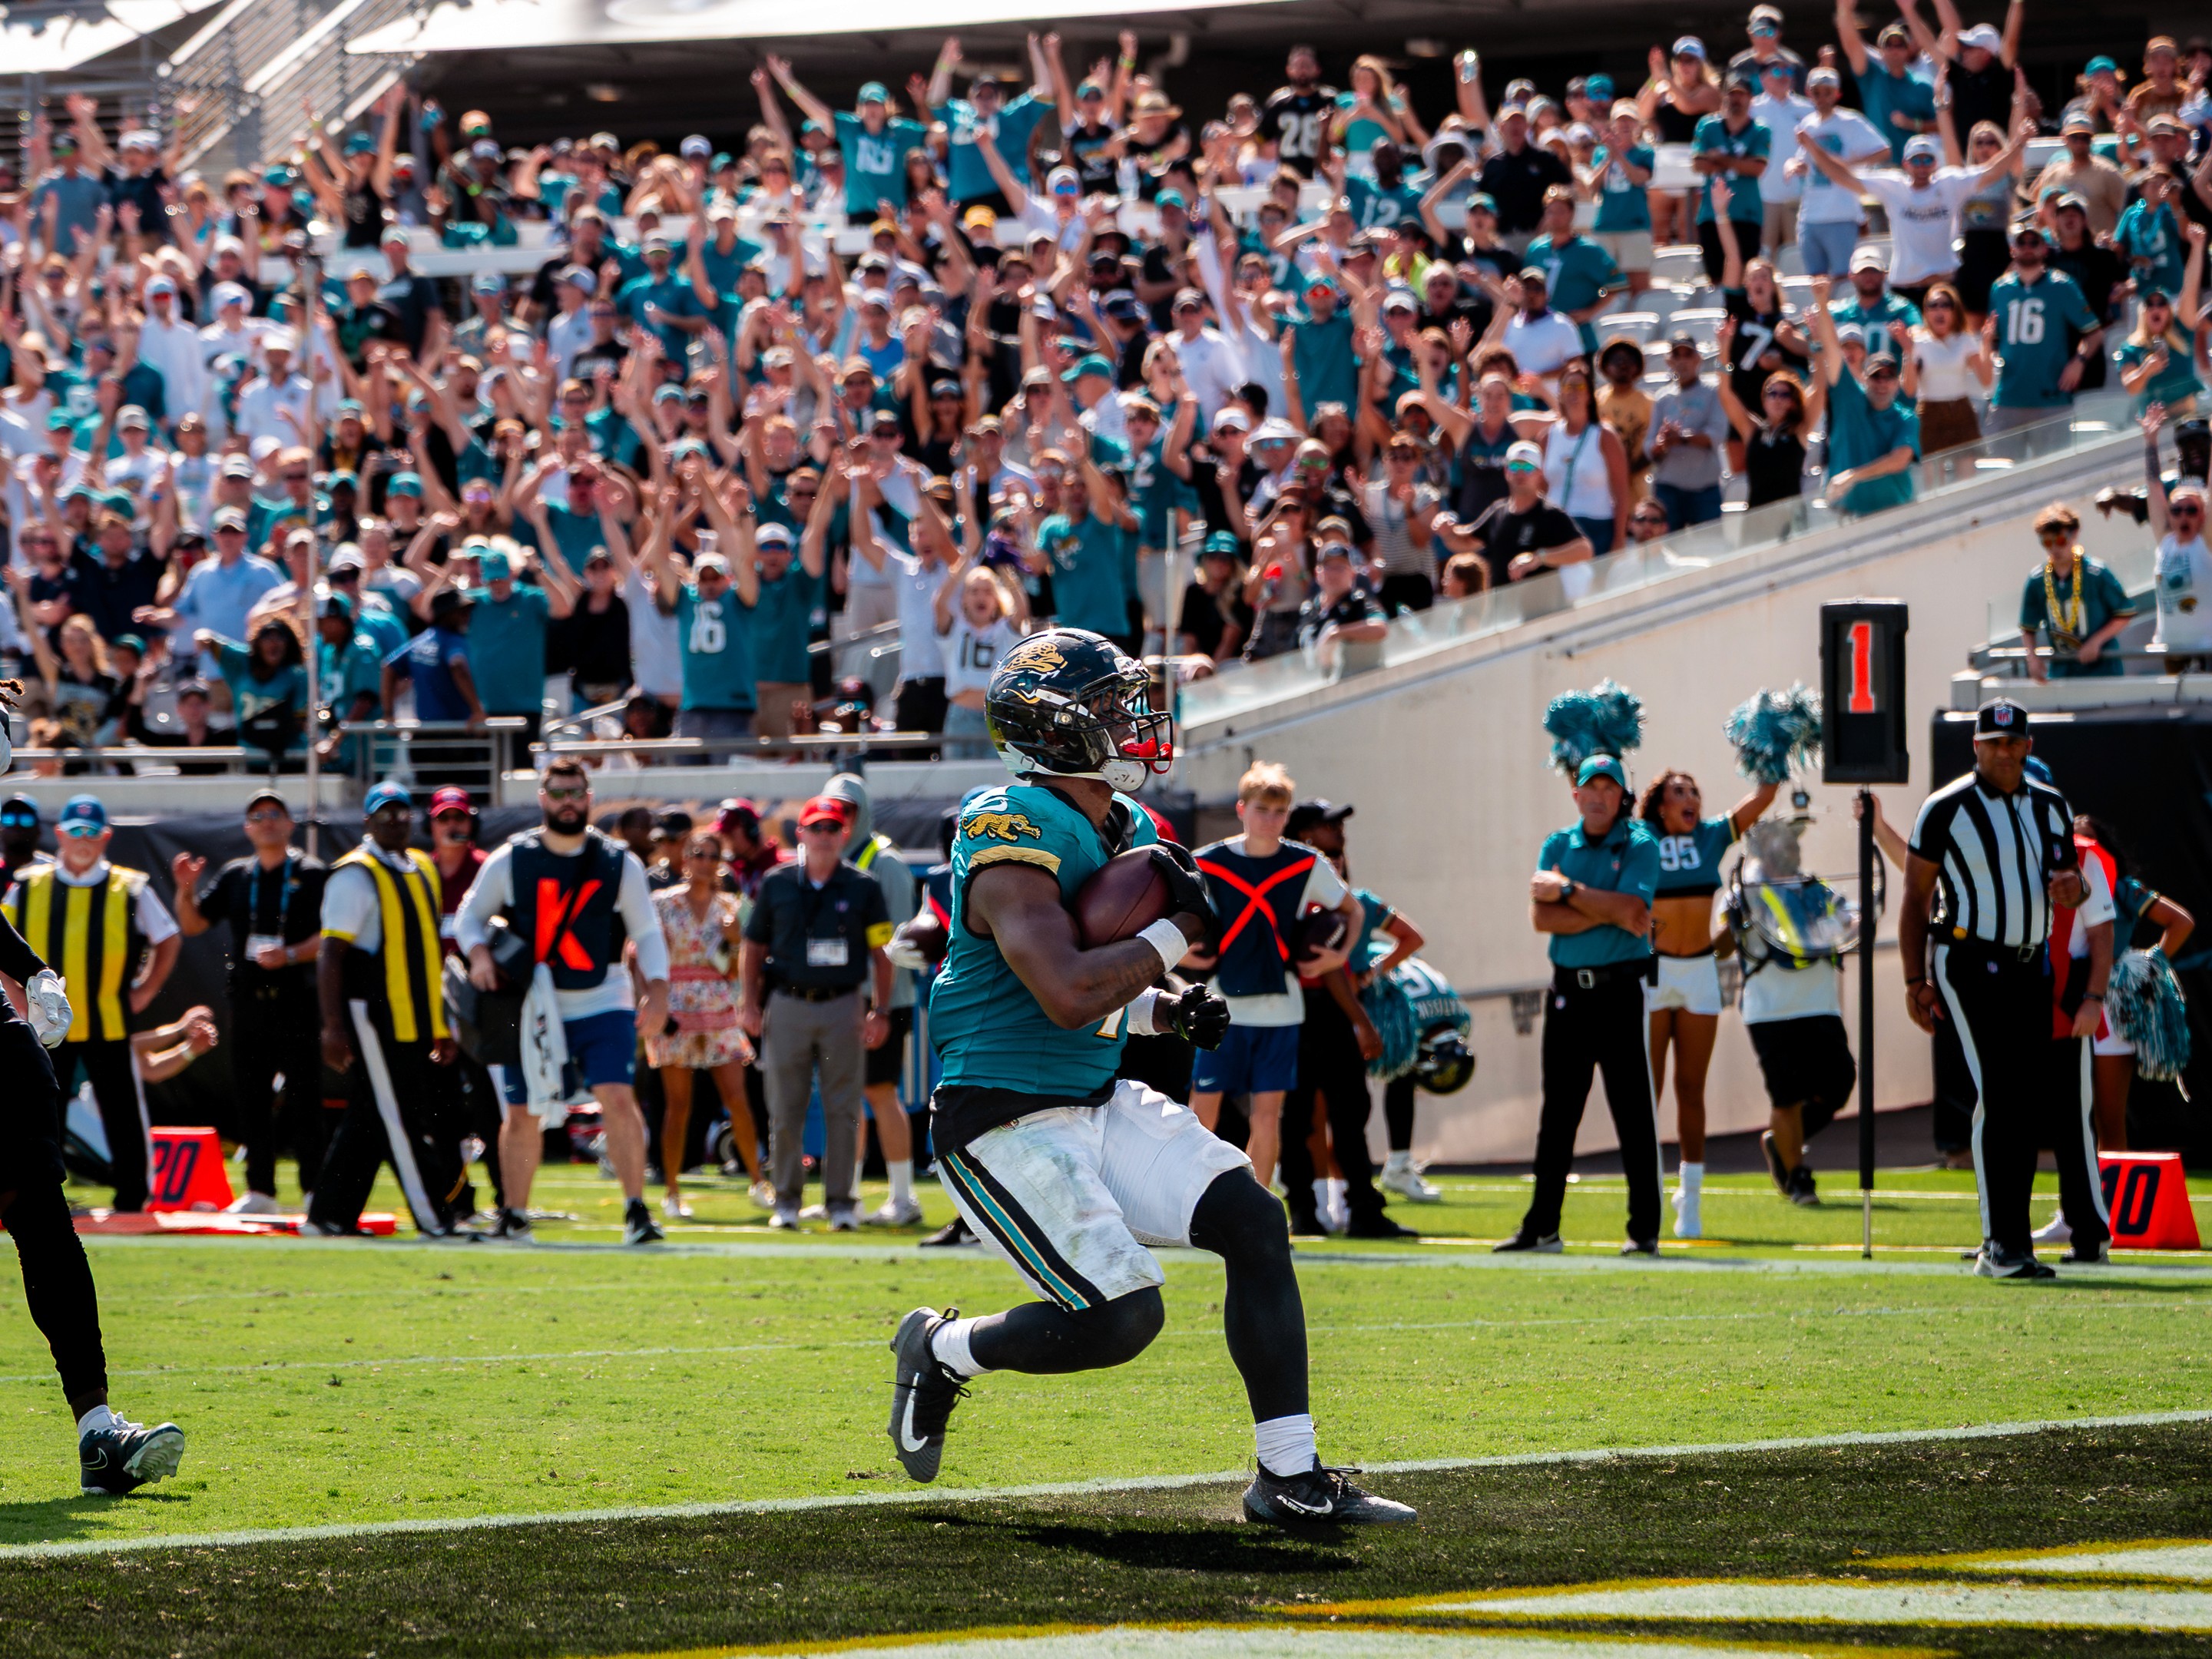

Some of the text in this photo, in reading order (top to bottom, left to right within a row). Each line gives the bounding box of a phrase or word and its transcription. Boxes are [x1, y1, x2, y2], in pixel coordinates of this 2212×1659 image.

[1740, 322, 1772, 371] 7
[2007, 298, 2045, 345] 16
[688, 601, 727, 654] 16
[961, 632, 995, 669] 16
[1846, 621, 1875, 713] 1
[1658, 836, 1700, 871] 95
[535, 878, 603, 972] K
[2101, 1164, 2161, 1235] 10
